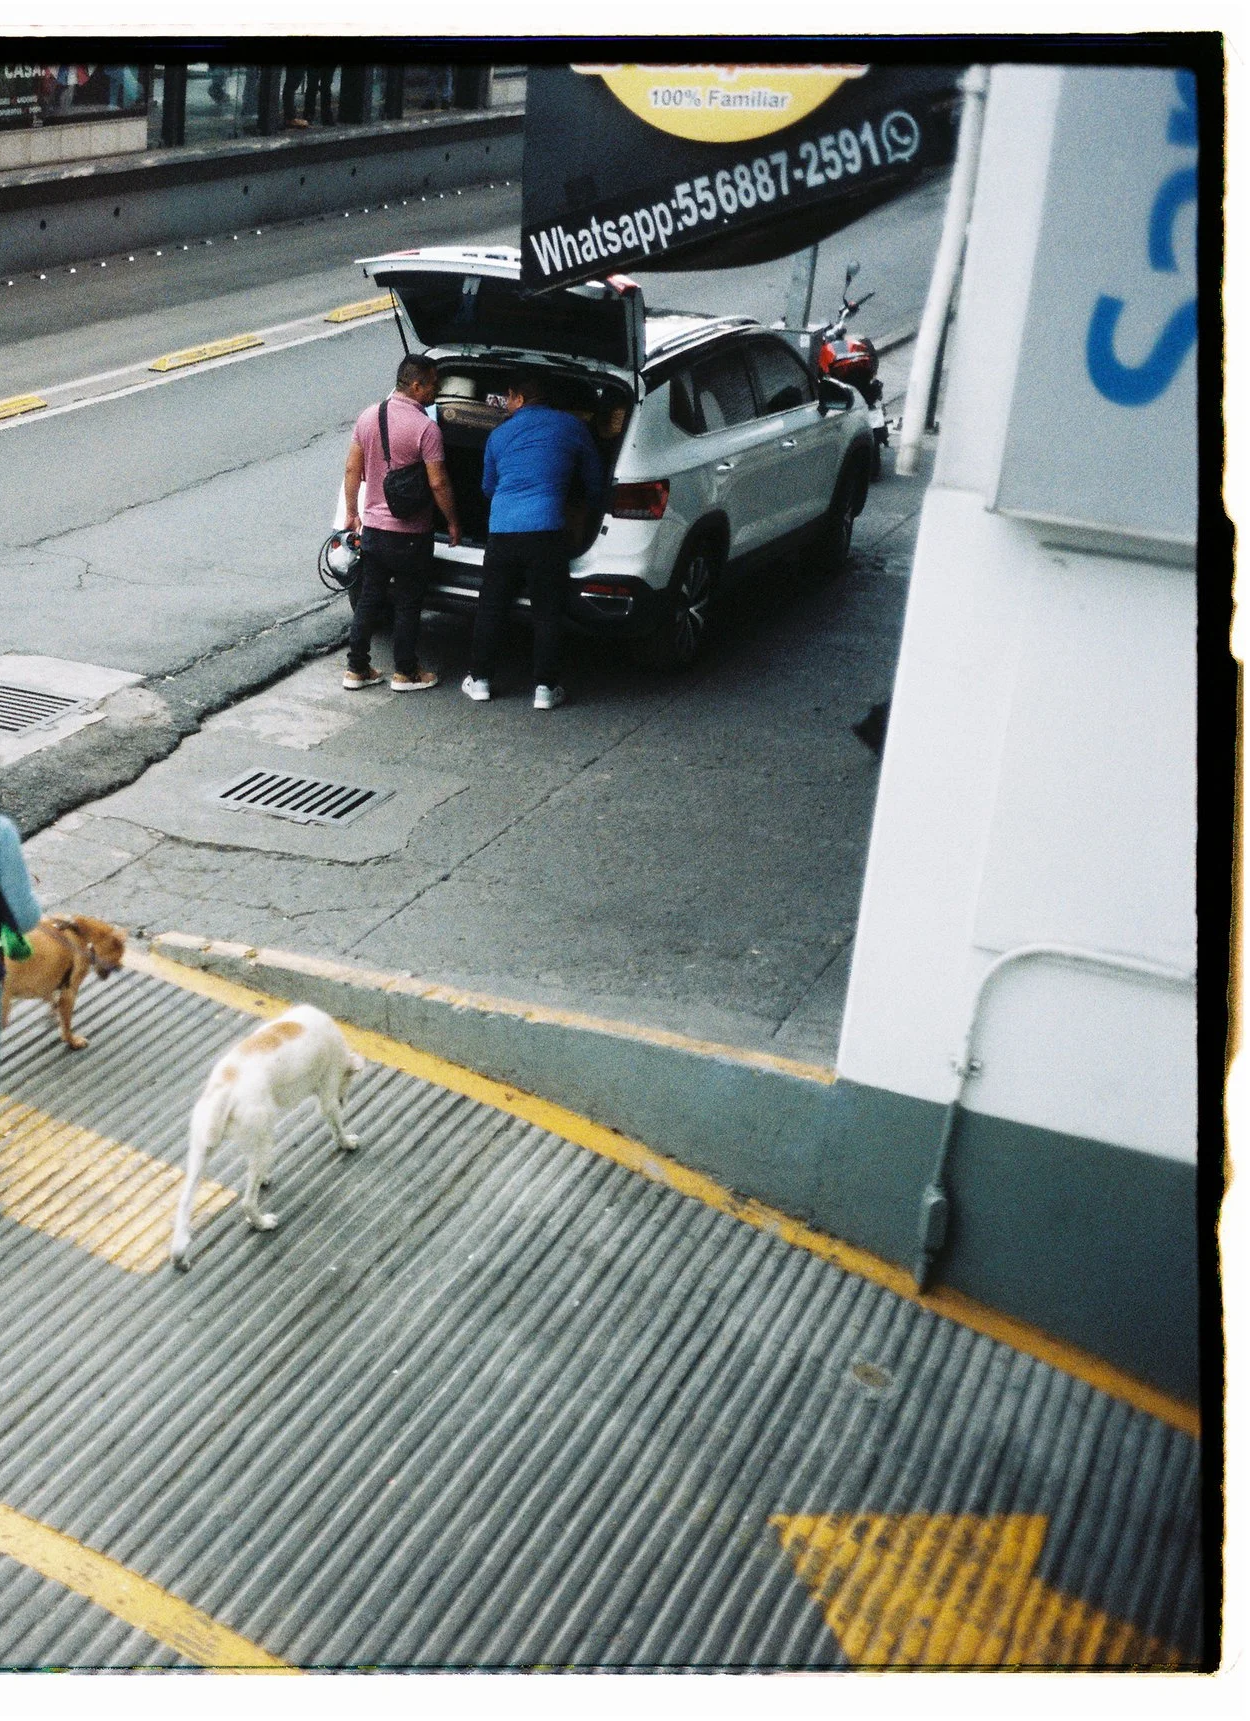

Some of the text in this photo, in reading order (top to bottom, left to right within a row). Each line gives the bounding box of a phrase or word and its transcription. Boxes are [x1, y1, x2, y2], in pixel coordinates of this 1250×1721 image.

[4, 63, 46, 79] CASA.
[652, 88, 790, 108] 100% Familiar
